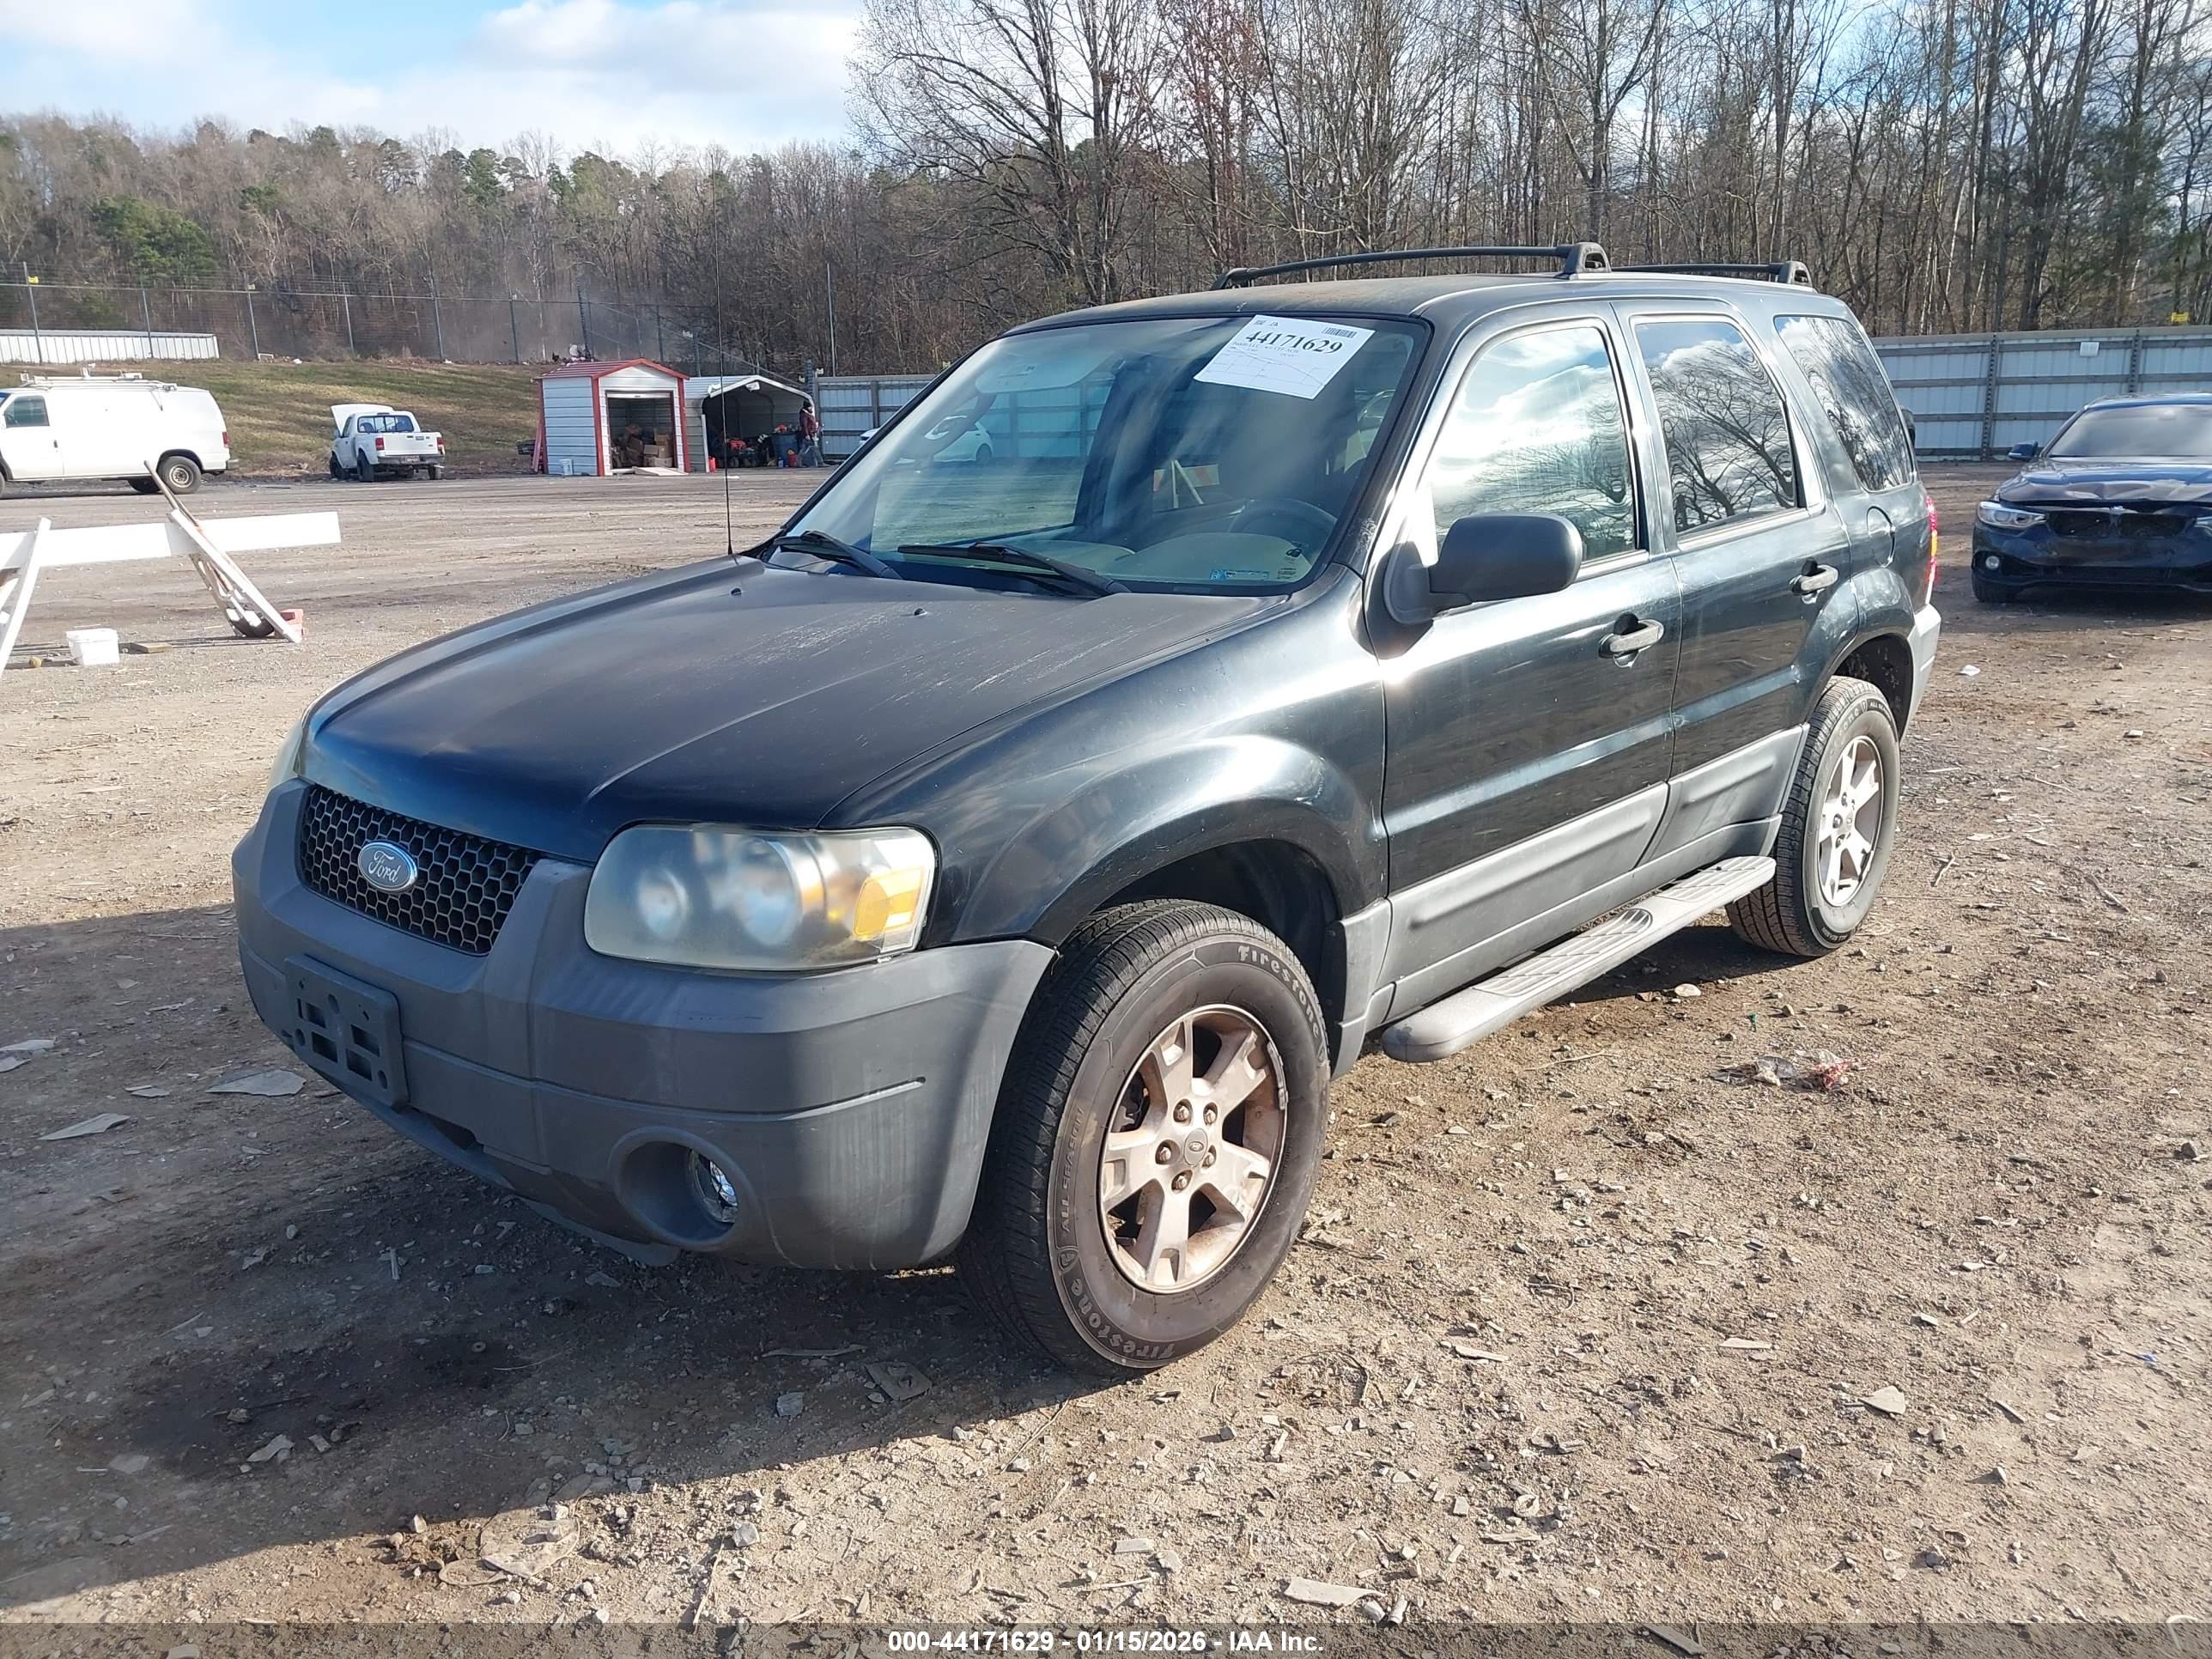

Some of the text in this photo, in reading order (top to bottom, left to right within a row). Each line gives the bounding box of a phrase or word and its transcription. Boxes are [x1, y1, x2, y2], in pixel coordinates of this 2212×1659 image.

[1245, 331, 1342, 354] 44171629
[368, 851, 401, 882] Ford
[1060, 1107, 1084, 1232] ALL SEASON
